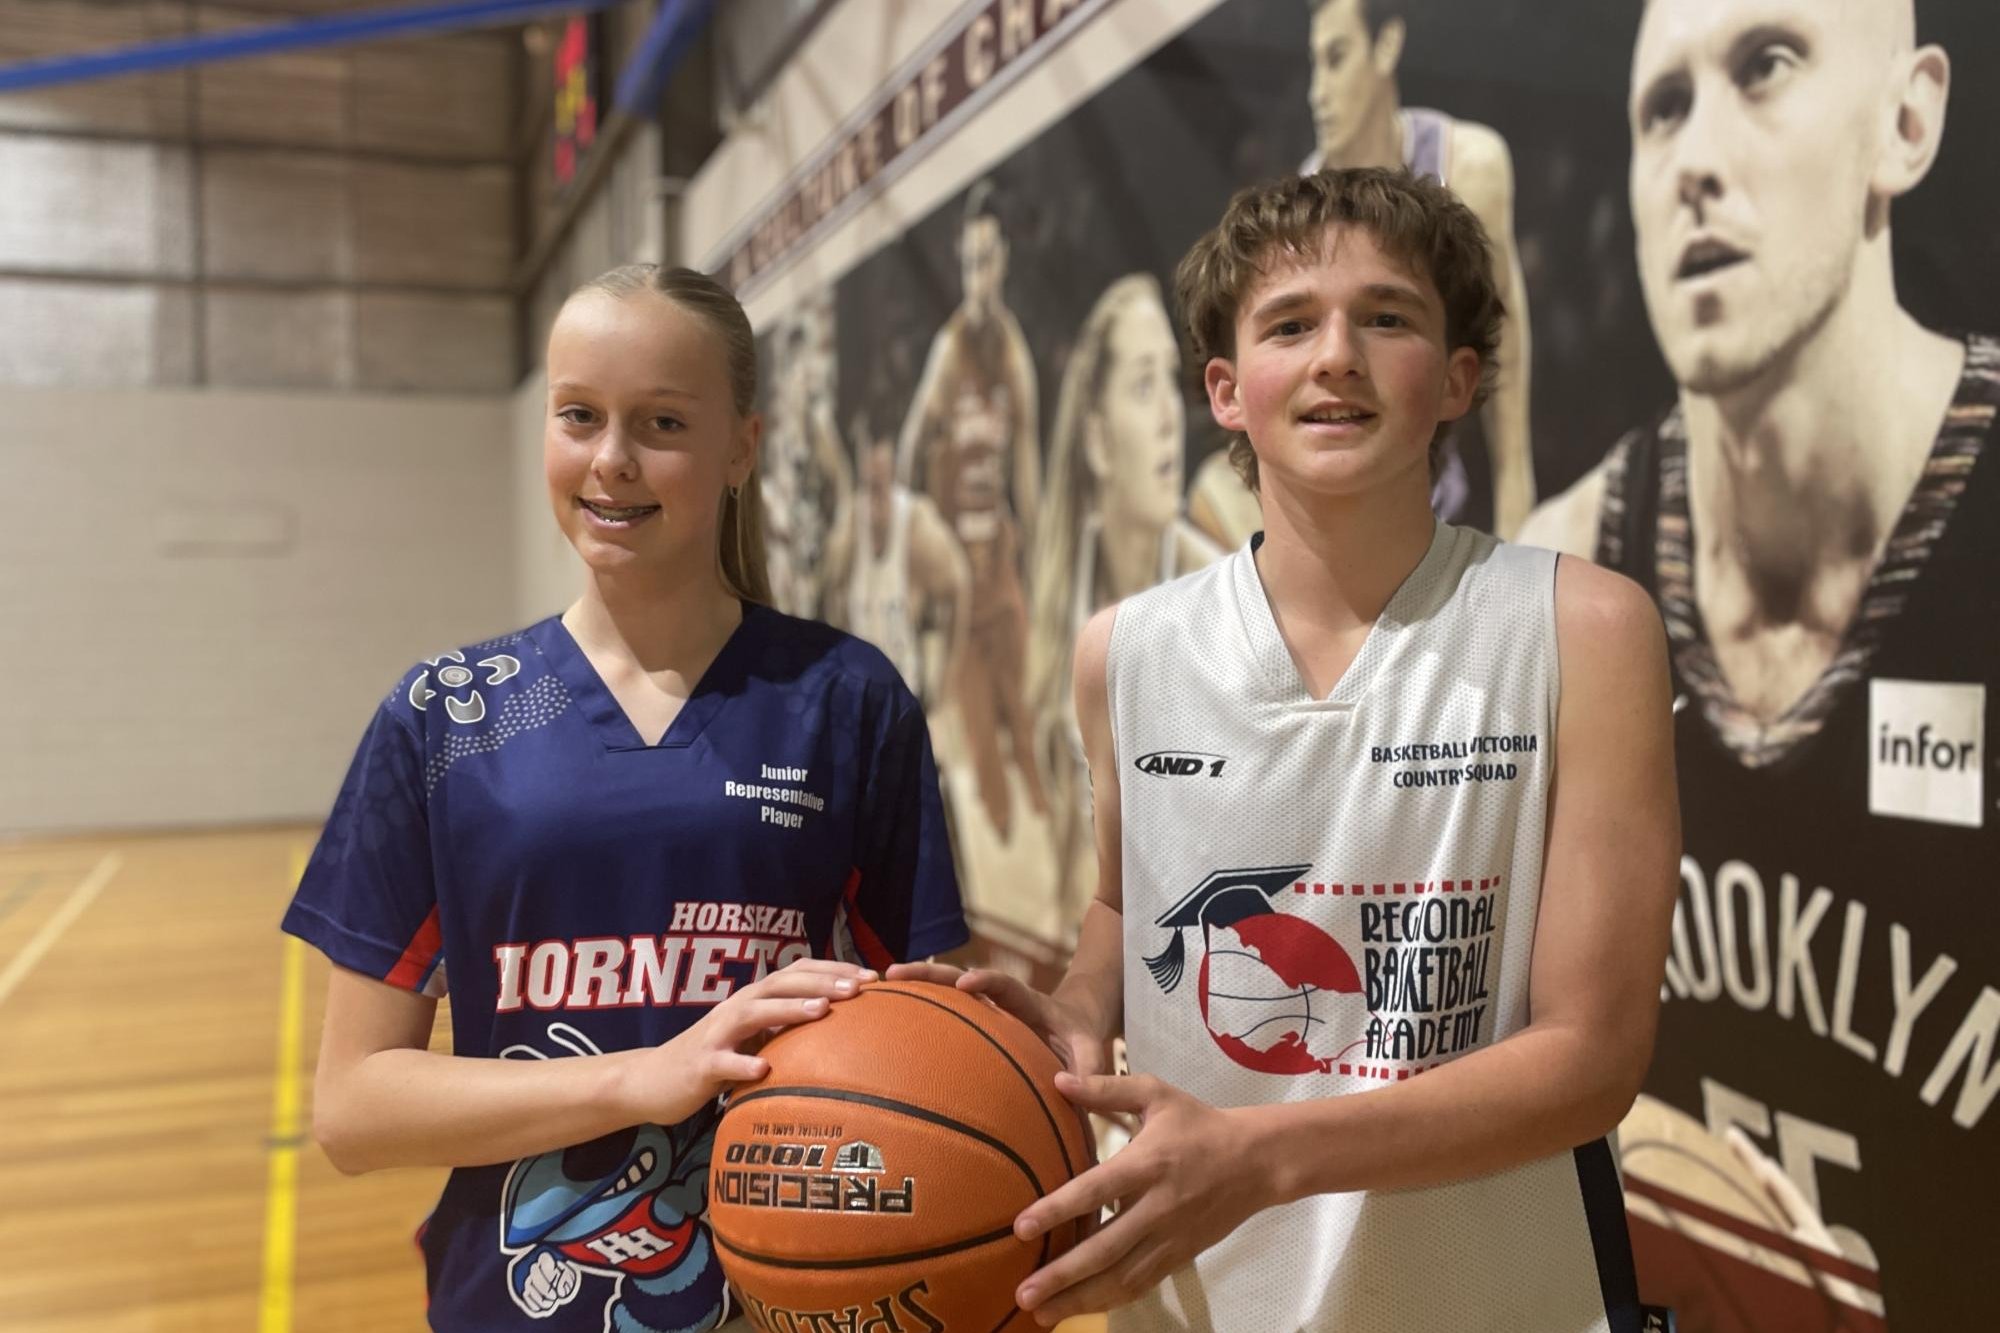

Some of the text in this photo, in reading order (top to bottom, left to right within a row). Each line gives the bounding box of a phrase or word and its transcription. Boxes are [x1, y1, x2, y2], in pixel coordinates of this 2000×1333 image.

[893, 53, 947, 147] OF
[1144, 756, 1204, 776] AND
[1879, 722, 1975, 773] infor
[725, 780, 825, 812] Representative
[761, 763, 808, 782] Junior
[1465, 763, 1518, 783] SQUAD
[761, 805, 804, 828] Player
[1360, 893, 1496, 943] REGIONAL
[1364, 937, 1491, 1013] BASKETBALL
[1660, 853, 2000, 1130] OOKLYN
[1366, 1004, 1487, 1061] ACADEMY
[752, 1122, 843, 1139] OFFICIAL GAME BALL
[725, 1143, 827, 1170] 1000
[713, 1168, 915, 1216] PRECISION
[745, 1279, 945, 1333] SPALD
